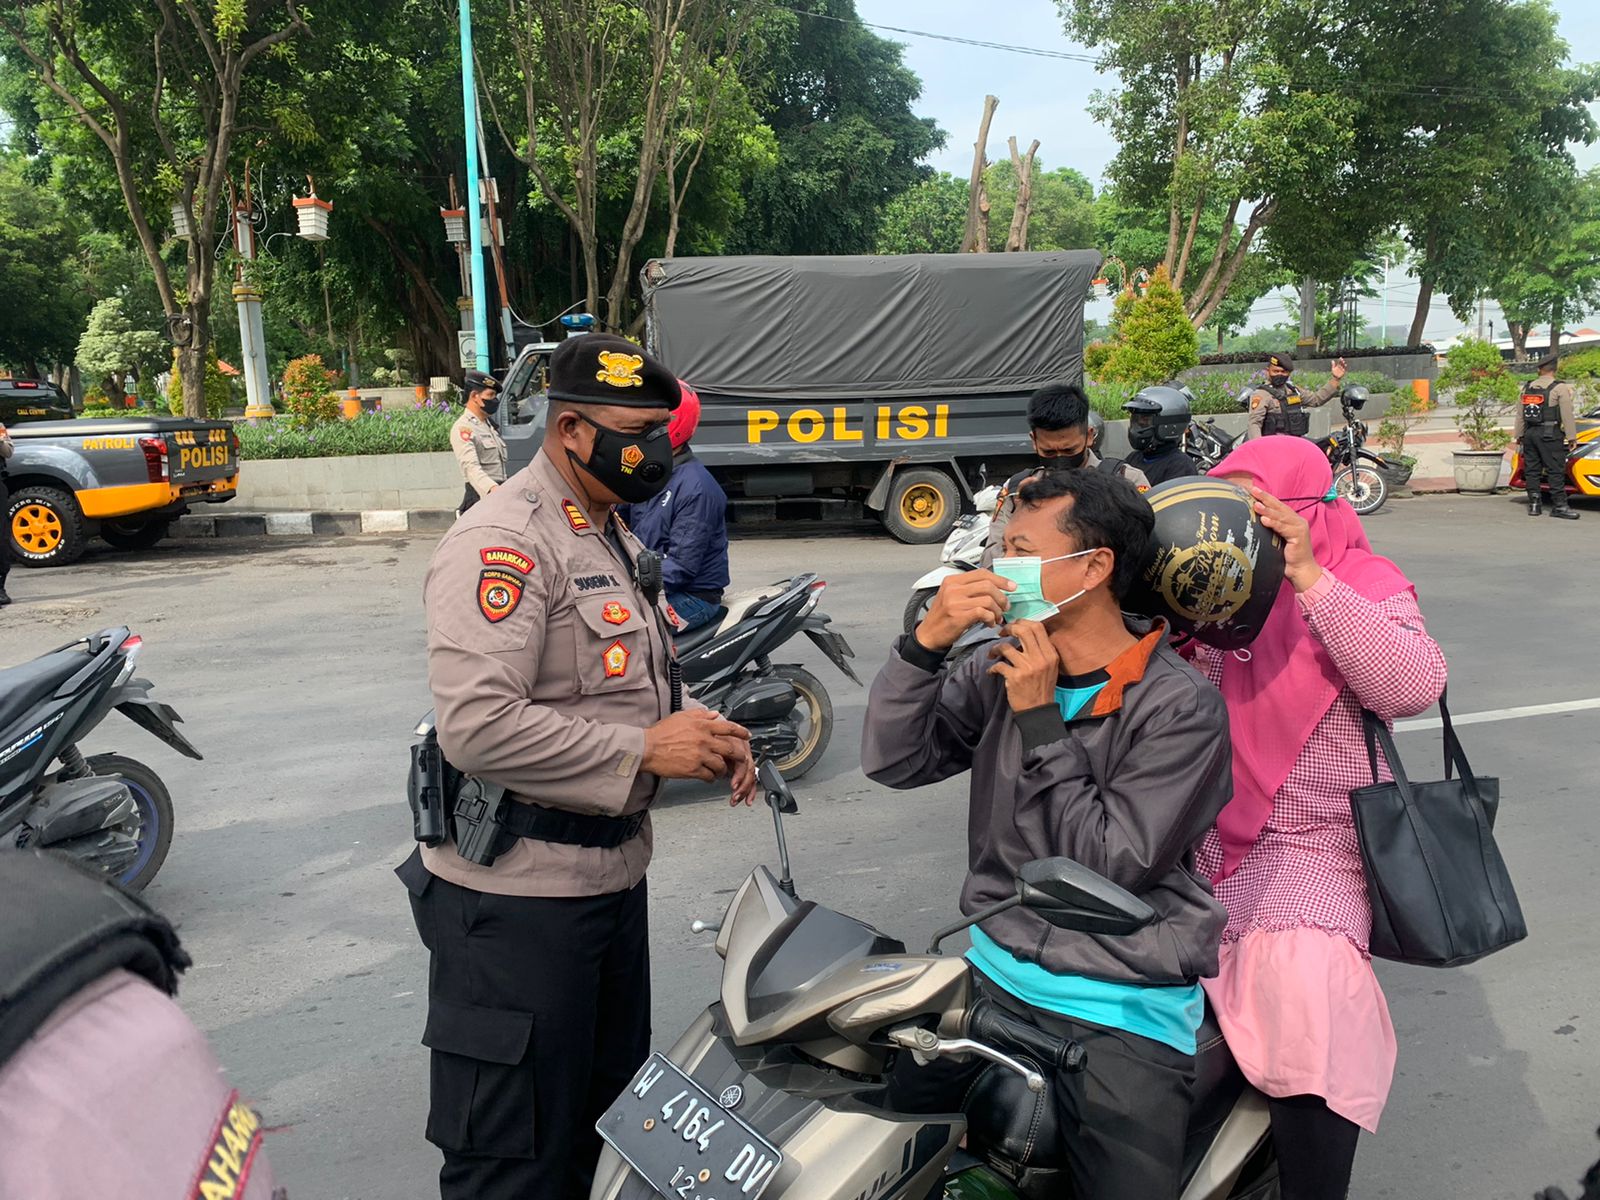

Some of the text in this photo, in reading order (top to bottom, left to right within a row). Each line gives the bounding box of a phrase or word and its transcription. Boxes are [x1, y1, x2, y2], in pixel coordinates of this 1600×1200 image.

[747, 403, 949, 444] POLISI
[82, 437, 135, 450] PATROLI
[179, 445, 229, 470] POLISI
[620, 465, 633, 475] TNI
[486, 551, 529, 570] BAHARKAM
[632, 1062, 773, 1194] W 4164 DV
